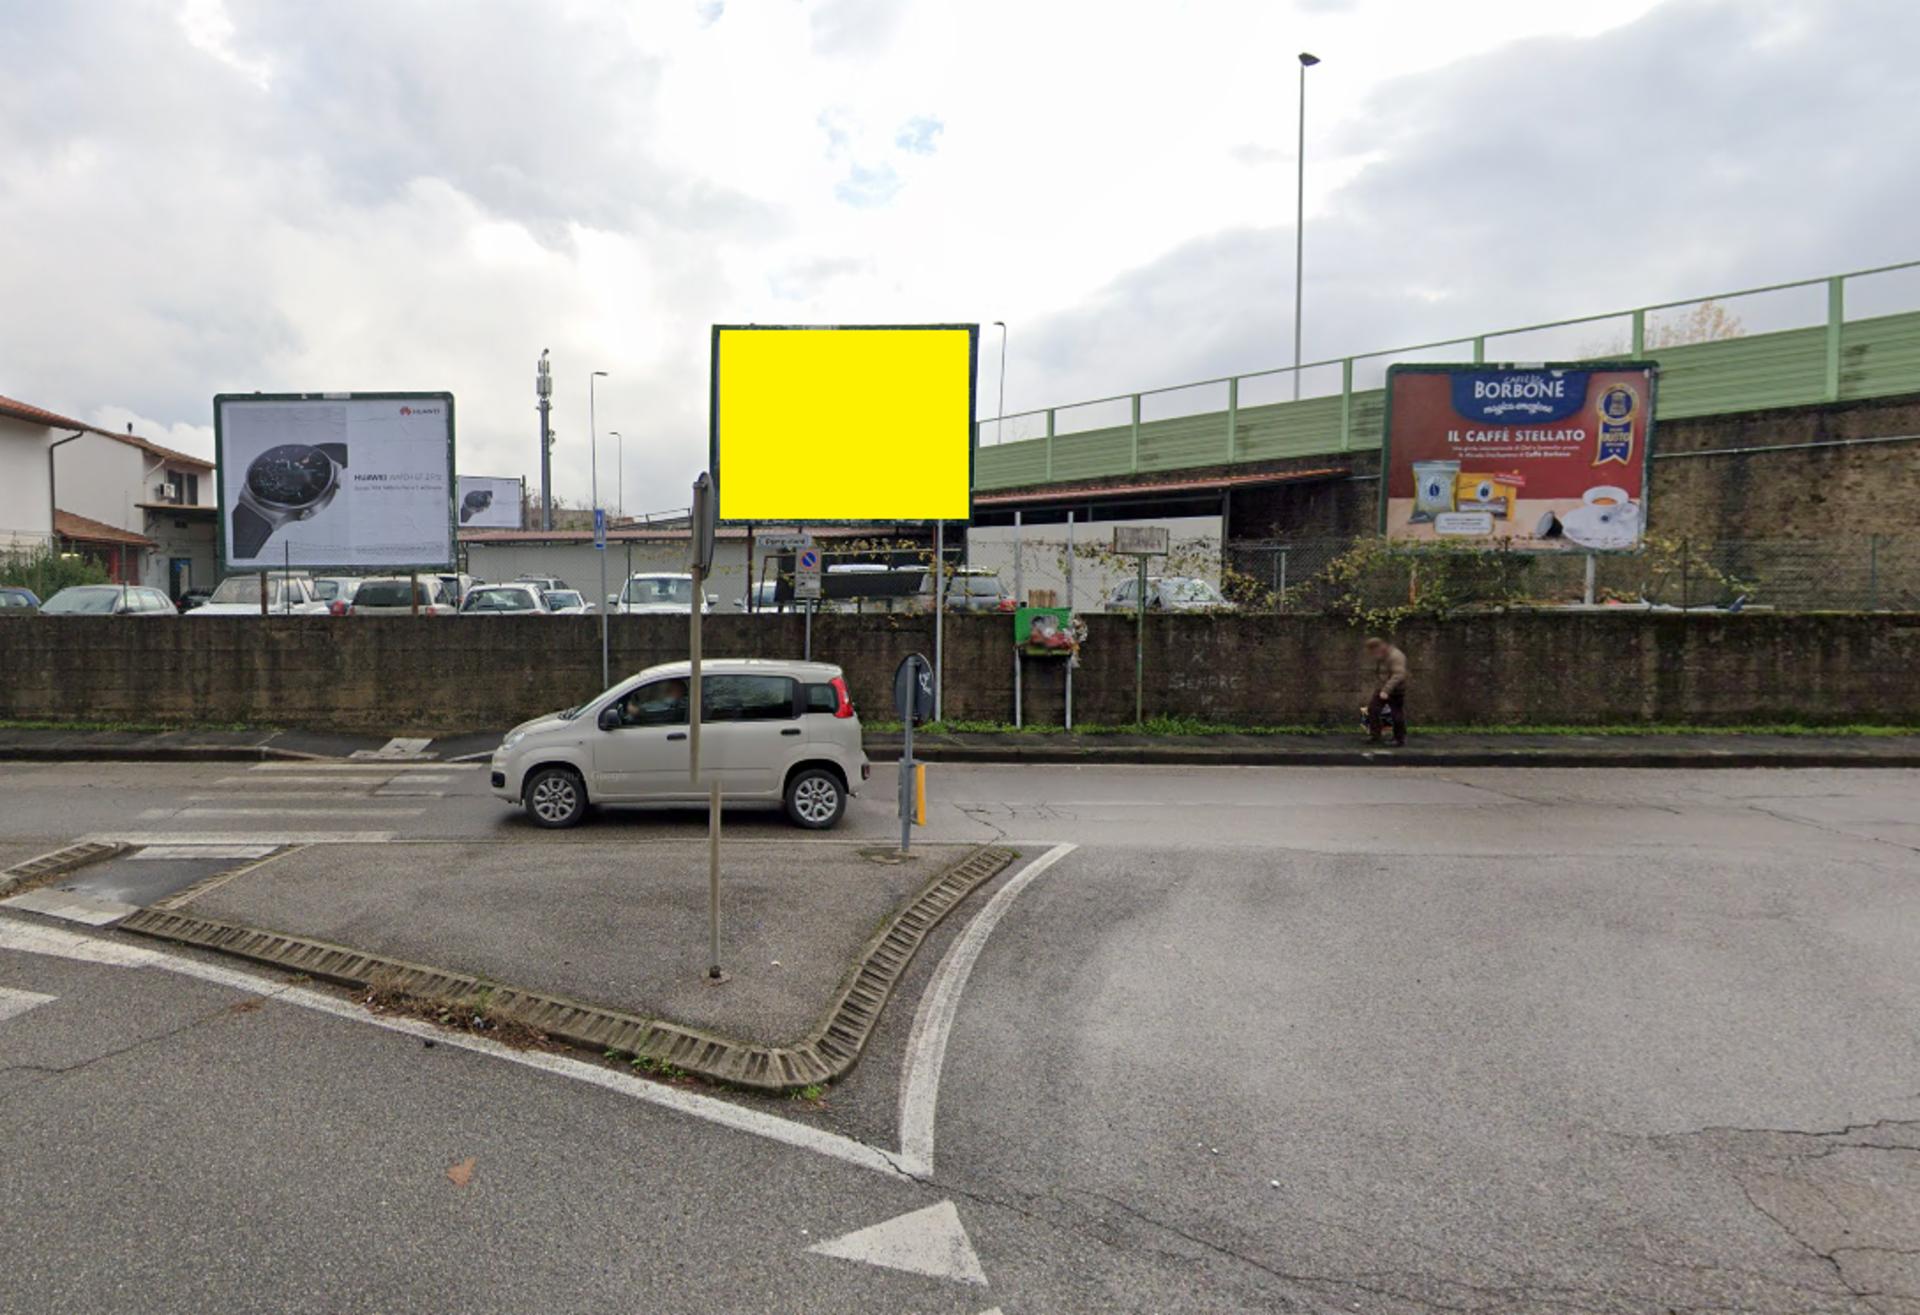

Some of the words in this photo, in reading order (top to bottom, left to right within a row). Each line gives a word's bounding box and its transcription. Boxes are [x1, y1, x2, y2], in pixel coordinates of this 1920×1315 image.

[1474, 380, 1565, 398] BORBONE
[1448, 430, 1460, 442] IL
[1466, 427, 1510, 442] CAFFÈ
[1515, 429, 1586, 442] STELLATO
[354, 473, 388, 482] HUAWEI
